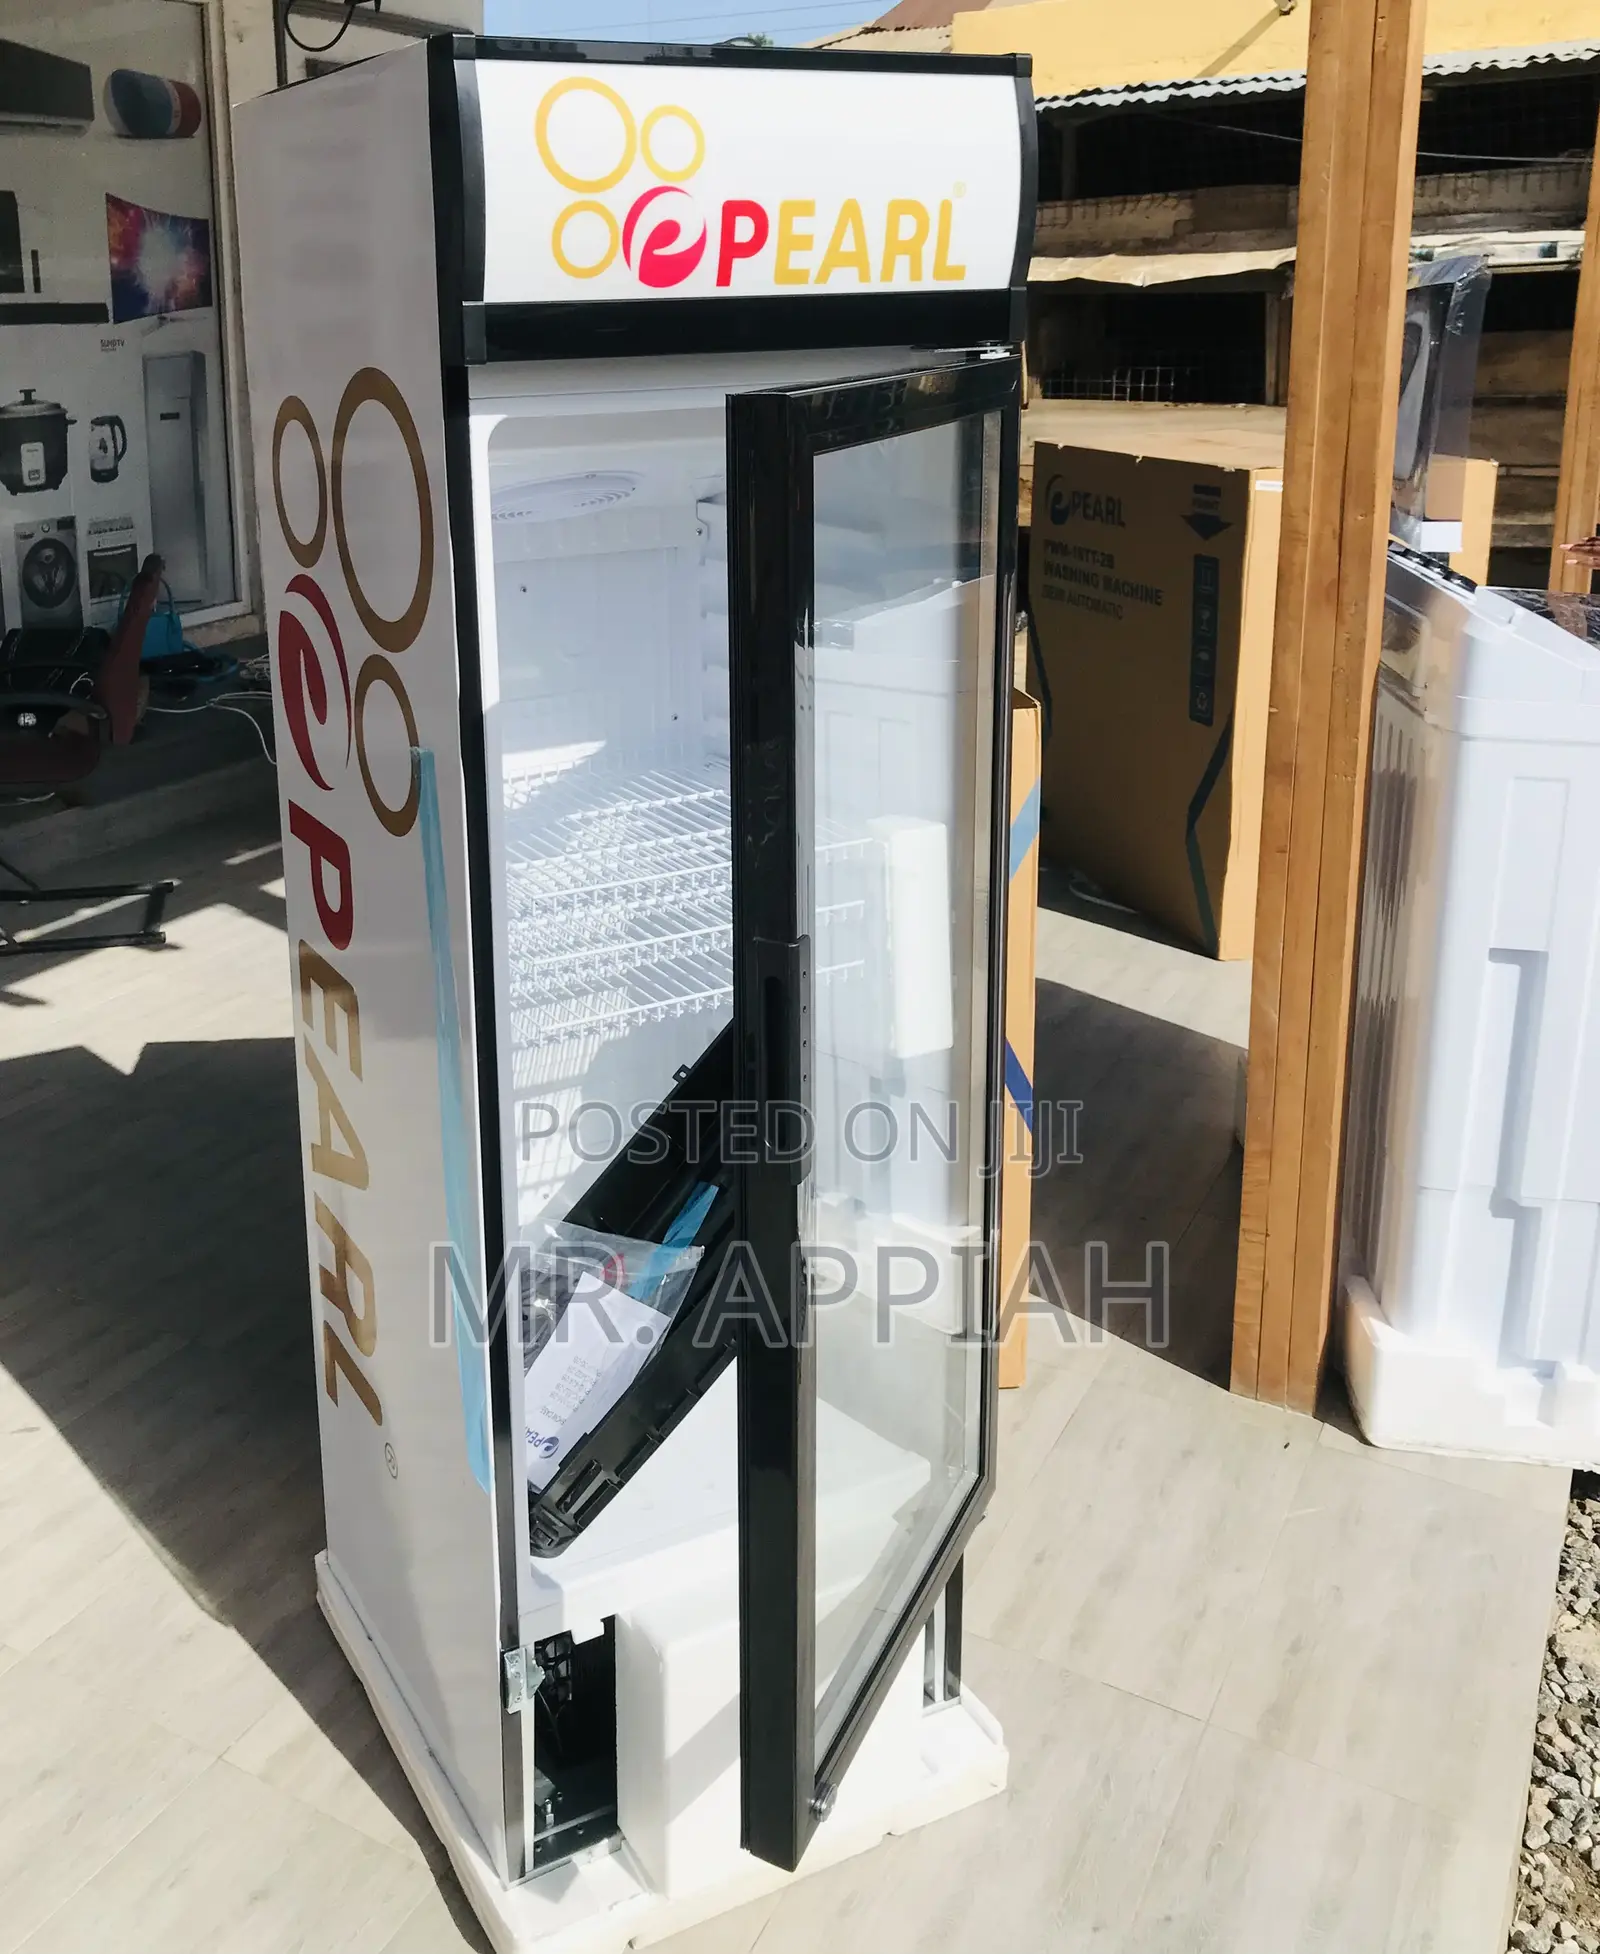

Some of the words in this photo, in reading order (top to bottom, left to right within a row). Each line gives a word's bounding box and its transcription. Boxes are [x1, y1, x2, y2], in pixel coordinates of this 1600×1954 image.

[716, 198, 966, 287] PEARL
[1072, 490, 1127, 528] PEARL
[1043, 559, 1100, 589] WASHING
[1103, 575, 1165, 607] MACHINE
[1067, 589, 1124, 621] AUTOMATIC
[288, 799, 383, 1426] PEARL
[525, 1426, 545, 1448] PEA
